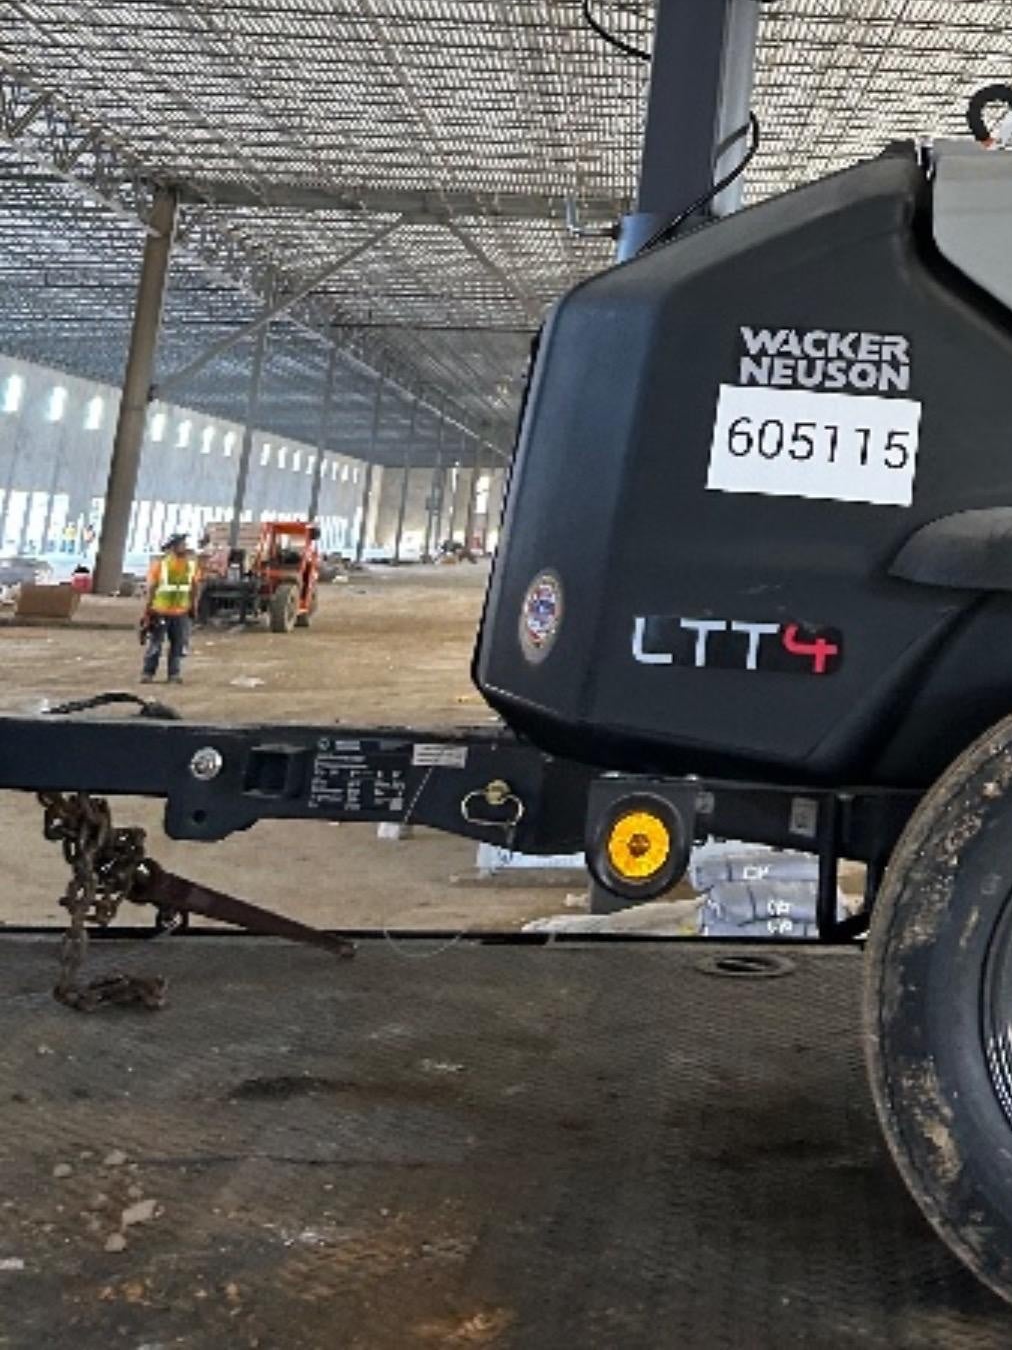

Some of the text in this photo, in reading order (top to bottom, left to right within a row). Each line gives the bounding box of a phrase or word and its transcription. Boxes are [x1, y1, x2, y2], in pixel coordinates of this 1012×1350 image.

[740, 326, 910, 363] WACKER
[740, 357, 910, 391] NEUSON
[728, 417, 910, 469] 605115
[632, 616, 838, 673] LTT4
